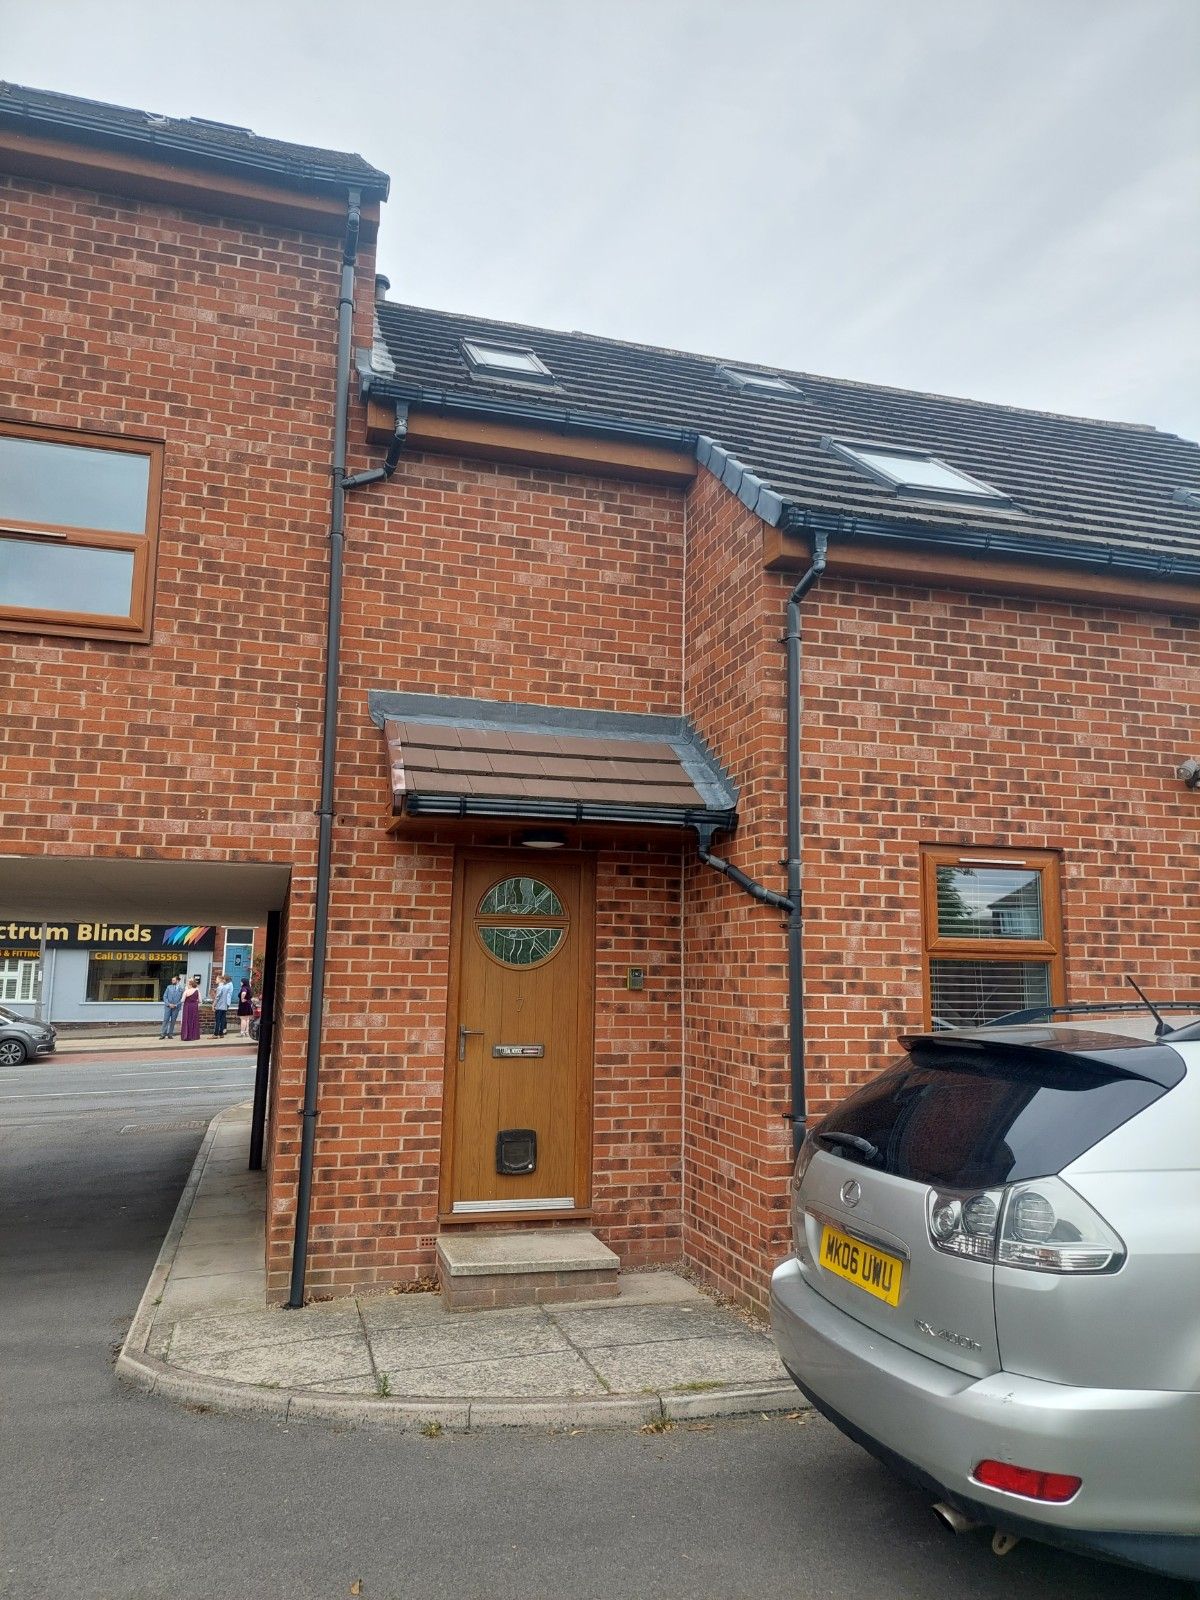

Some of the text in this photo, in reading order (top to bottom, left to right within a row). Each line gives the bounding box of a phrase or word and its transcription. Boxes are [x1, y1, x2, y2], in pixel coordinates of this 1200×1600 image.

[77, 923, 152, 942] Blinds
[94, 952, 183, 961] Call 01924 835561
[825, 1233, 860, 1275] MK06
[861, 1251, 894, 1292] UWU
